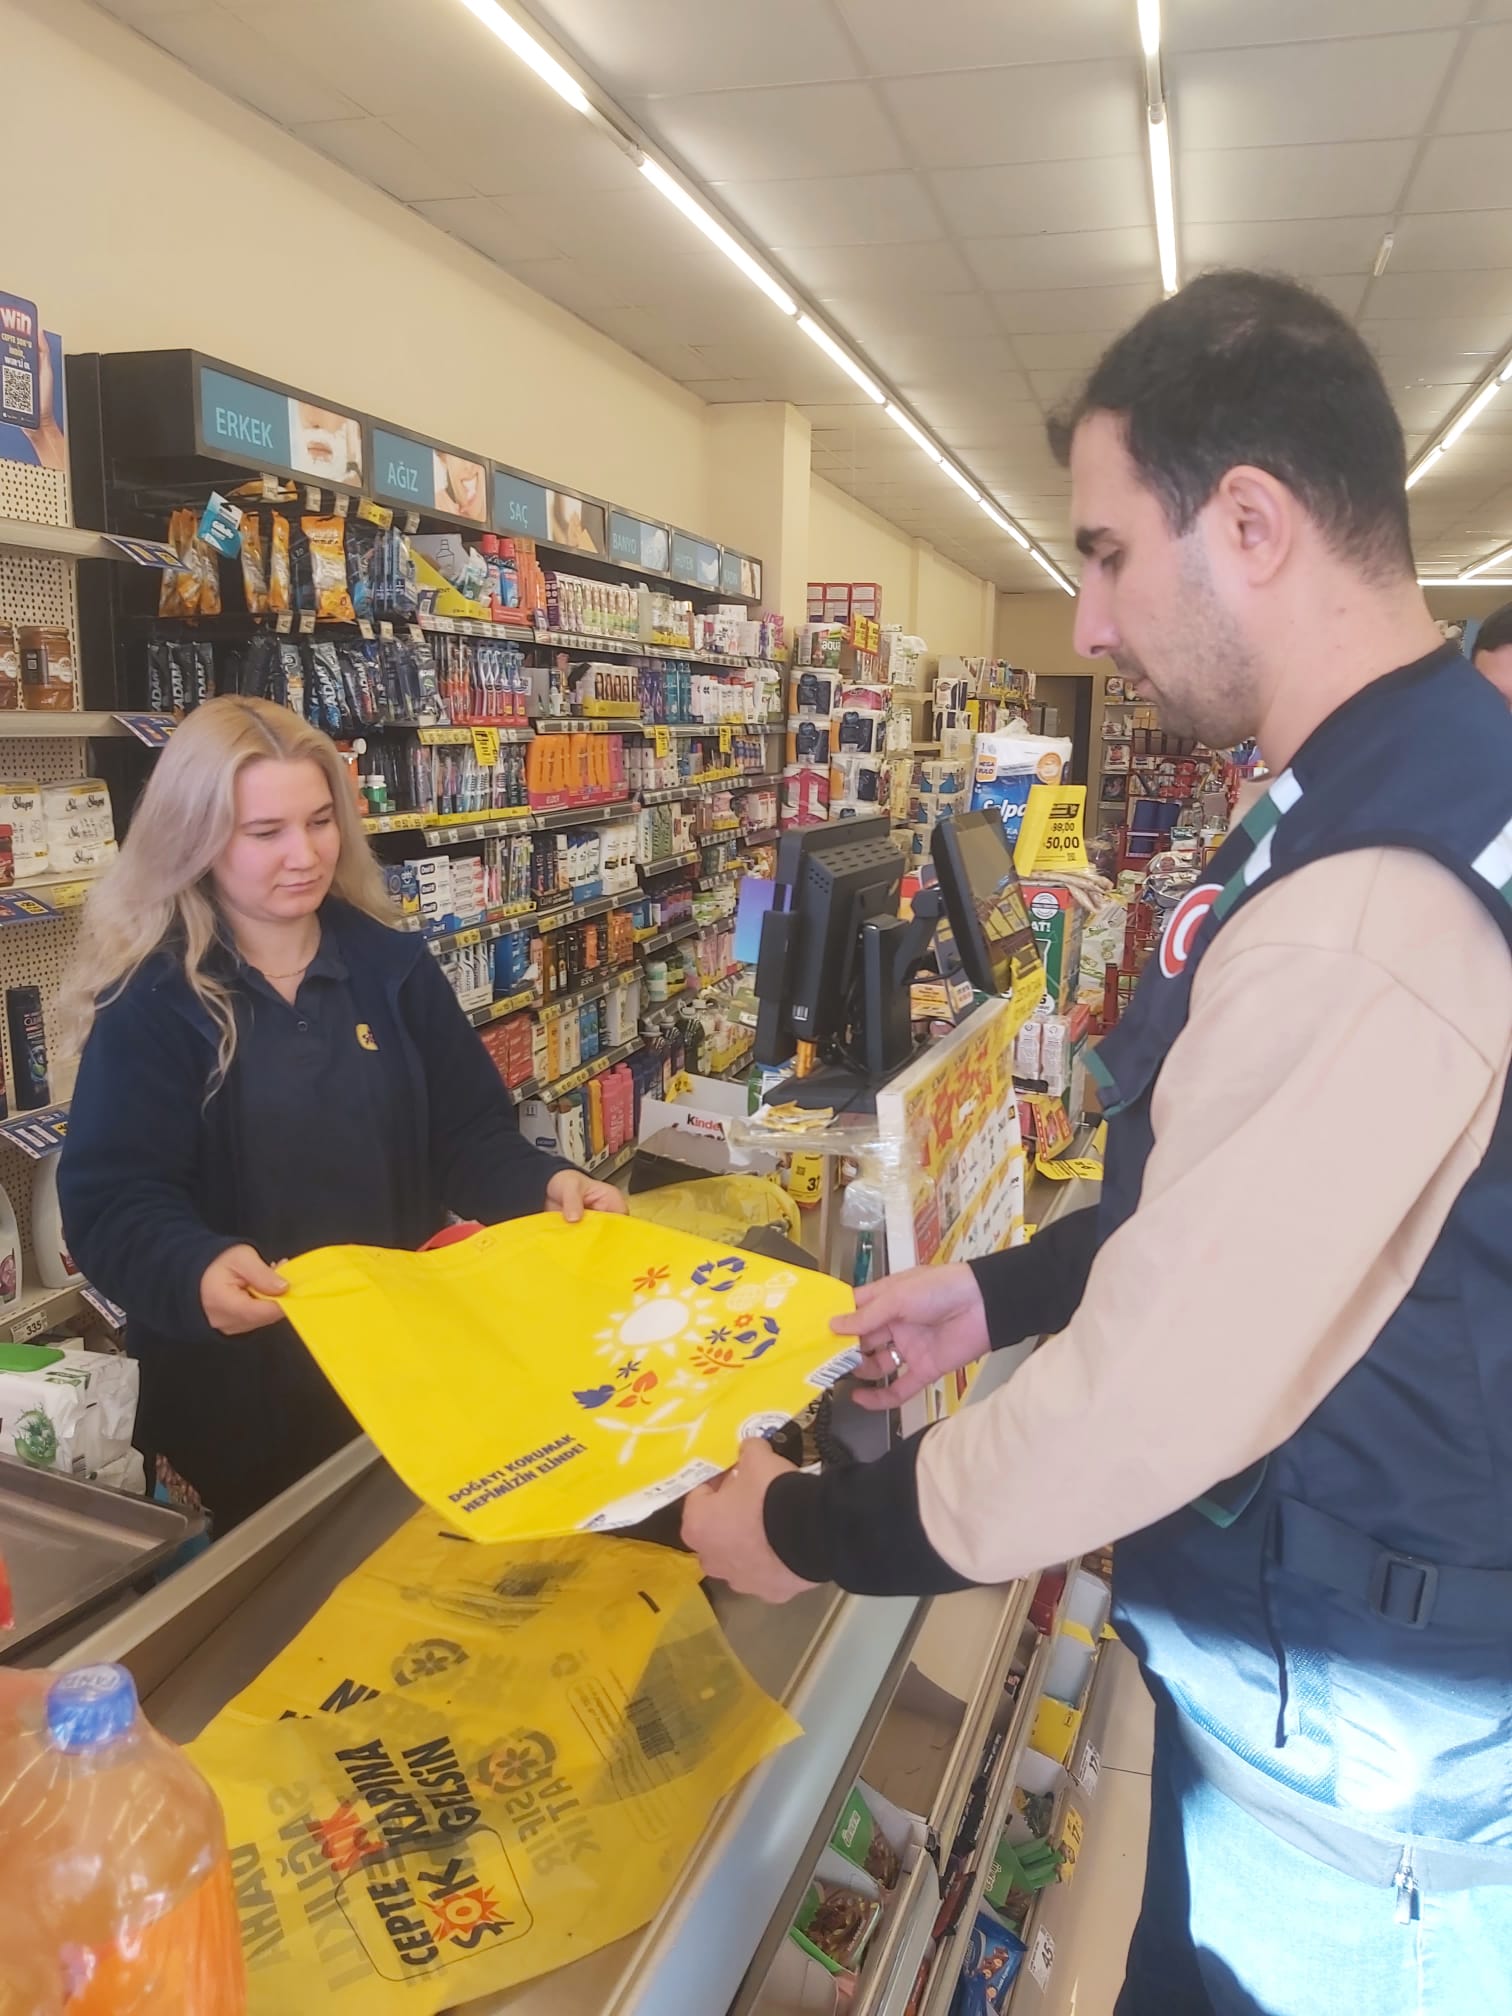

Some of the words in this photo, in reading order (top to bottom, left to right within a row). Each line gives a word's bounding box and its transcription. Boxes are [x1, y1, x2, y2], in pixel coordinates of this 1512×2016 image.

[215, 407, 273, 448] ERKEK
[387, 461, 418, 492] AĞIZ
[509, 501, 528, 528] SAÇ
[448, 1469, 506, 1503] DOĞAYI
[504, 1434, 577, 1472] KORUMAK
[461, 1470, 539, 1513] HEPİMİZİN
[335, 1738, 432, 1847] KAPINA
[366, 1877, 440, 1966] CEPTE
[417, 1858, 515, 1950] ŞOK
